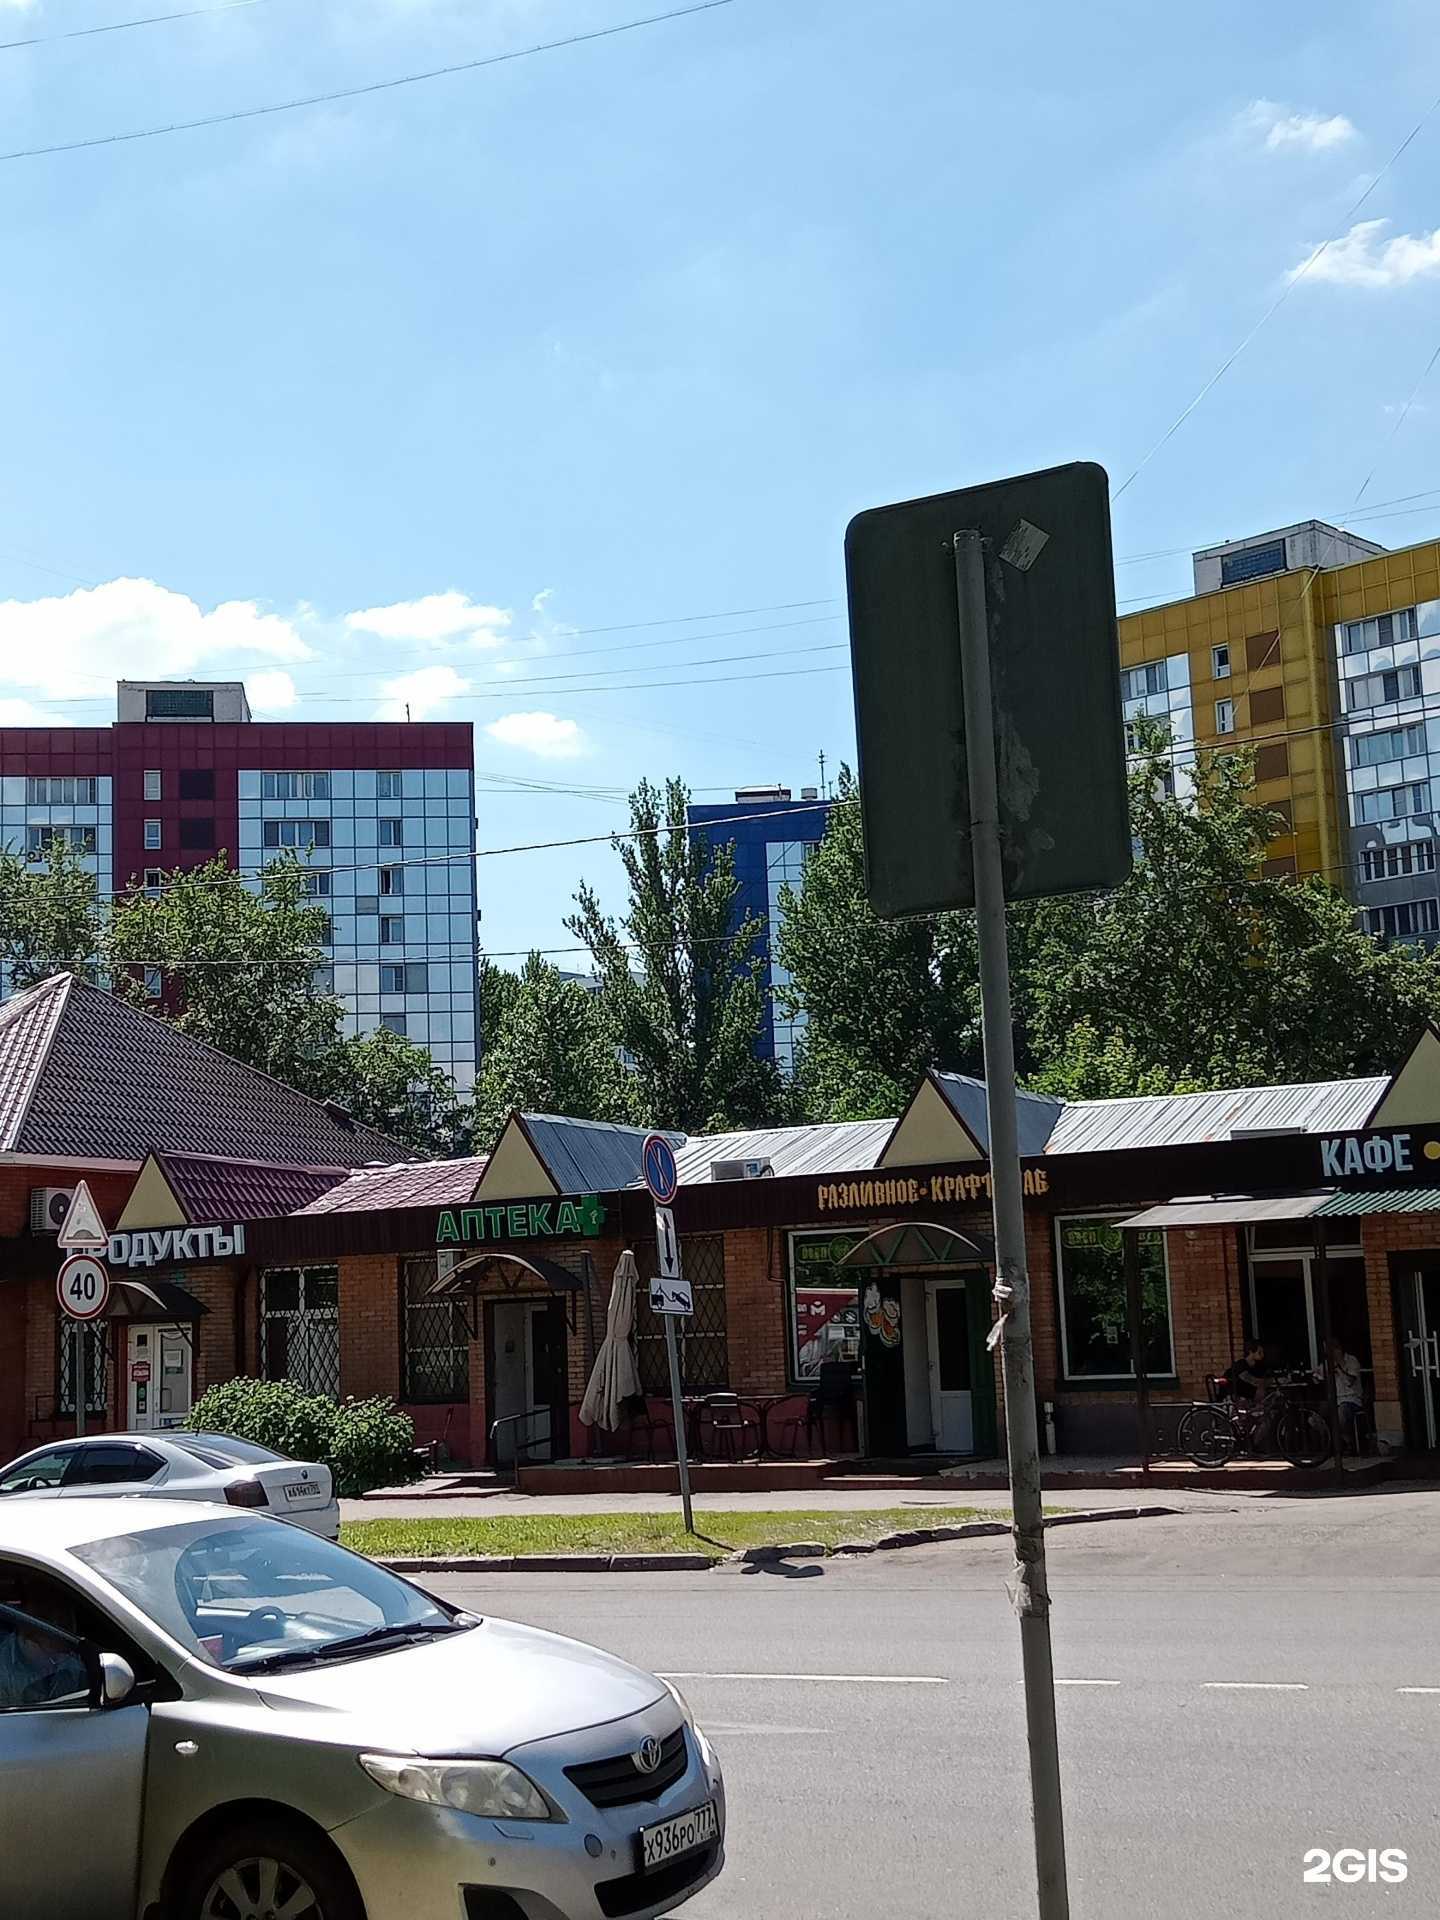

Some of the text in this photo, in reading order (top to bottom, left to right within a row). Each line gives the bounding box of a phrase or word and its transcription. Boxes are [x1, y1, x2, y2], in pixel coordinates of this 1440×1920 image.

[1320, 1133, 1414, 1177] КАФЕ
[817, 1178, 919, 1211] РАЗЛИВНОЕ
[436, 1201, 581, 1243] АПТЕКА
[66, 1224, 246, 1268] ОДУКТЫ
[69, 1272, 96, 1301] 40
